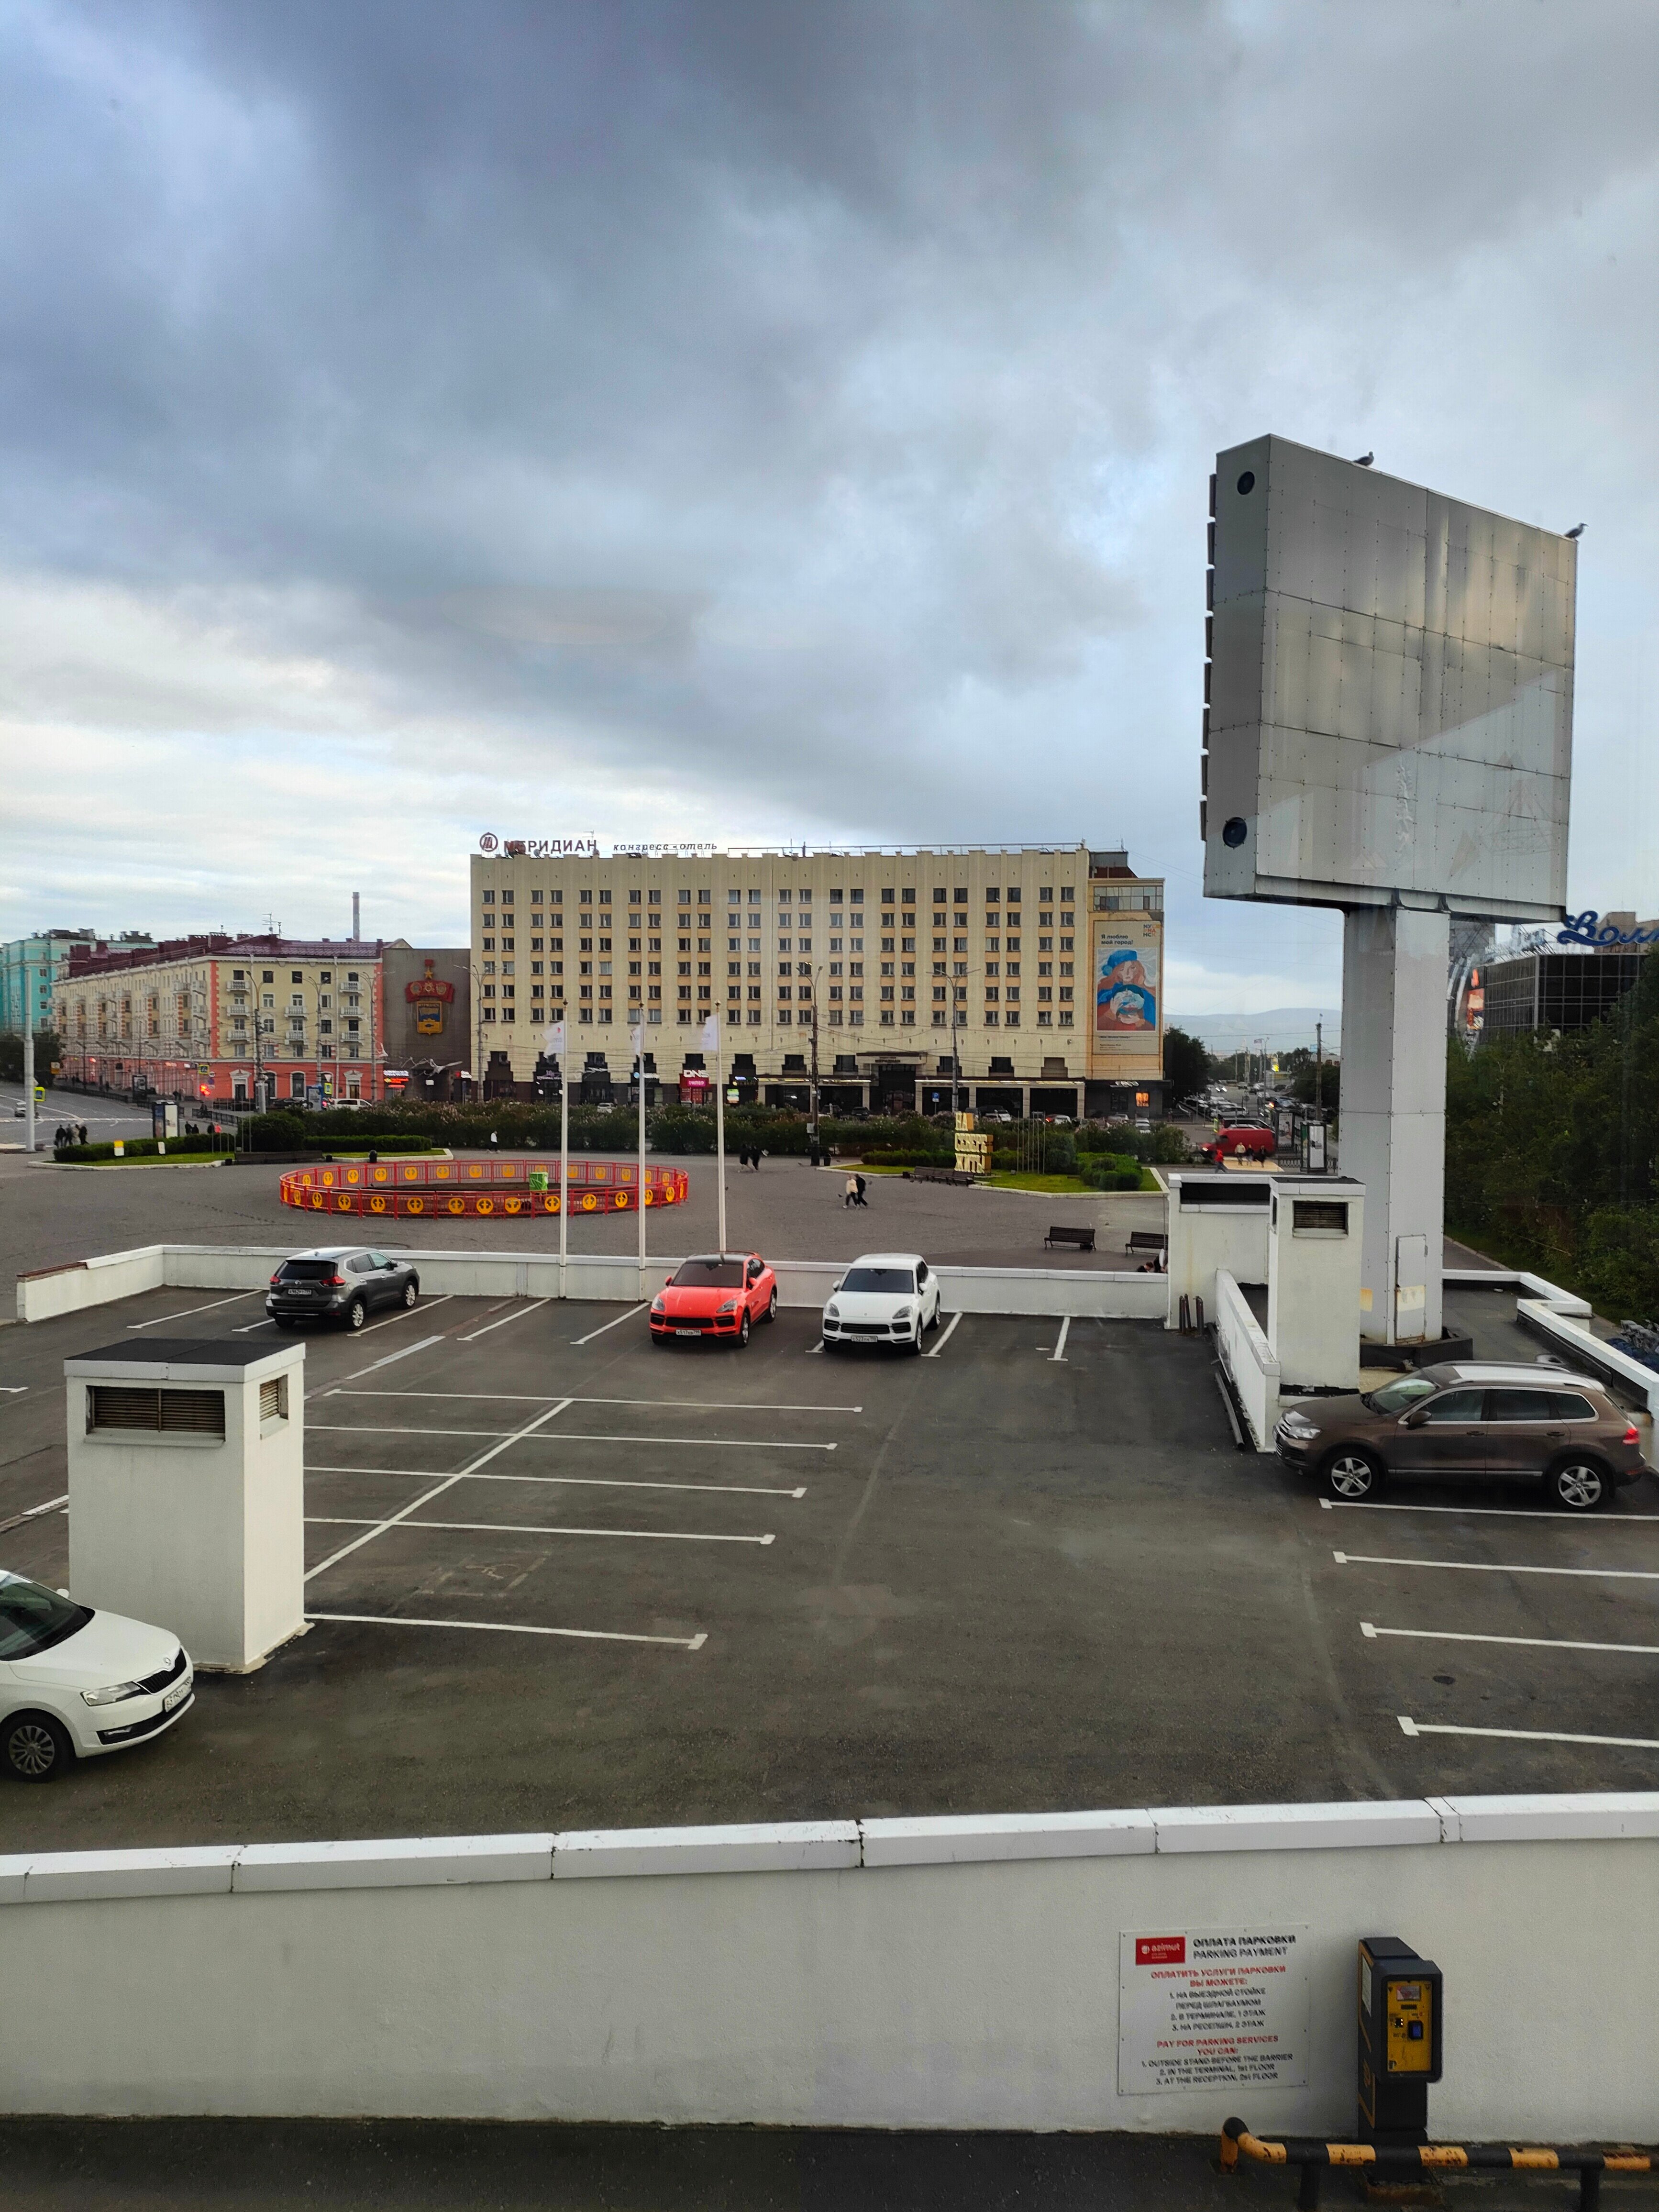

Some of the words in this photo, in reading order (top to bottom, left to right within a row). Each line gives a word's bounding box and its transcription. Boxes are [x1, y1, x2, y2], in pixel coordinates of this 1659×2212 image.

[504, 840, 597, 854] МРИДИАН
[683, 1070, 709, 1078] DNS
[1194, 1937, 1237, 1947] ОПЛАТА
[1239, 1935, 1296, 1945] ПАРКОВКИ
[1151, 1943, 1180, 1951] azimut
[1194, 1949, 1237, 1959] PARKING
[1239, 1947, 1287, 1957] PAYMENT
[1151, 1970, 1199, 1979] ОПЛАТИТЬ
[1201, 1968, 1236, 1976] УСЛУГИ
[1238, 1966, 1286, 1975] ПАРКОВКИ
[1206, 1978, 1248, 1986] МОЖЕТЕ:
[1189, 1988, 1234, 1998] ВЫЕЗДНОЙ
[1235, 1987, 1265, 1996] СТОЙКЕ
[1176, 2002, 1202, 2010] ПЕРЕД
[1196, 2038, 1235, 2046] PARKING
[1237, 2035, 1279, 2044] SERVICES
[1149, 2059, 1182, 2067] OUTSIDE
[1194, 2066, 1235, 2074] TERMINAL,
